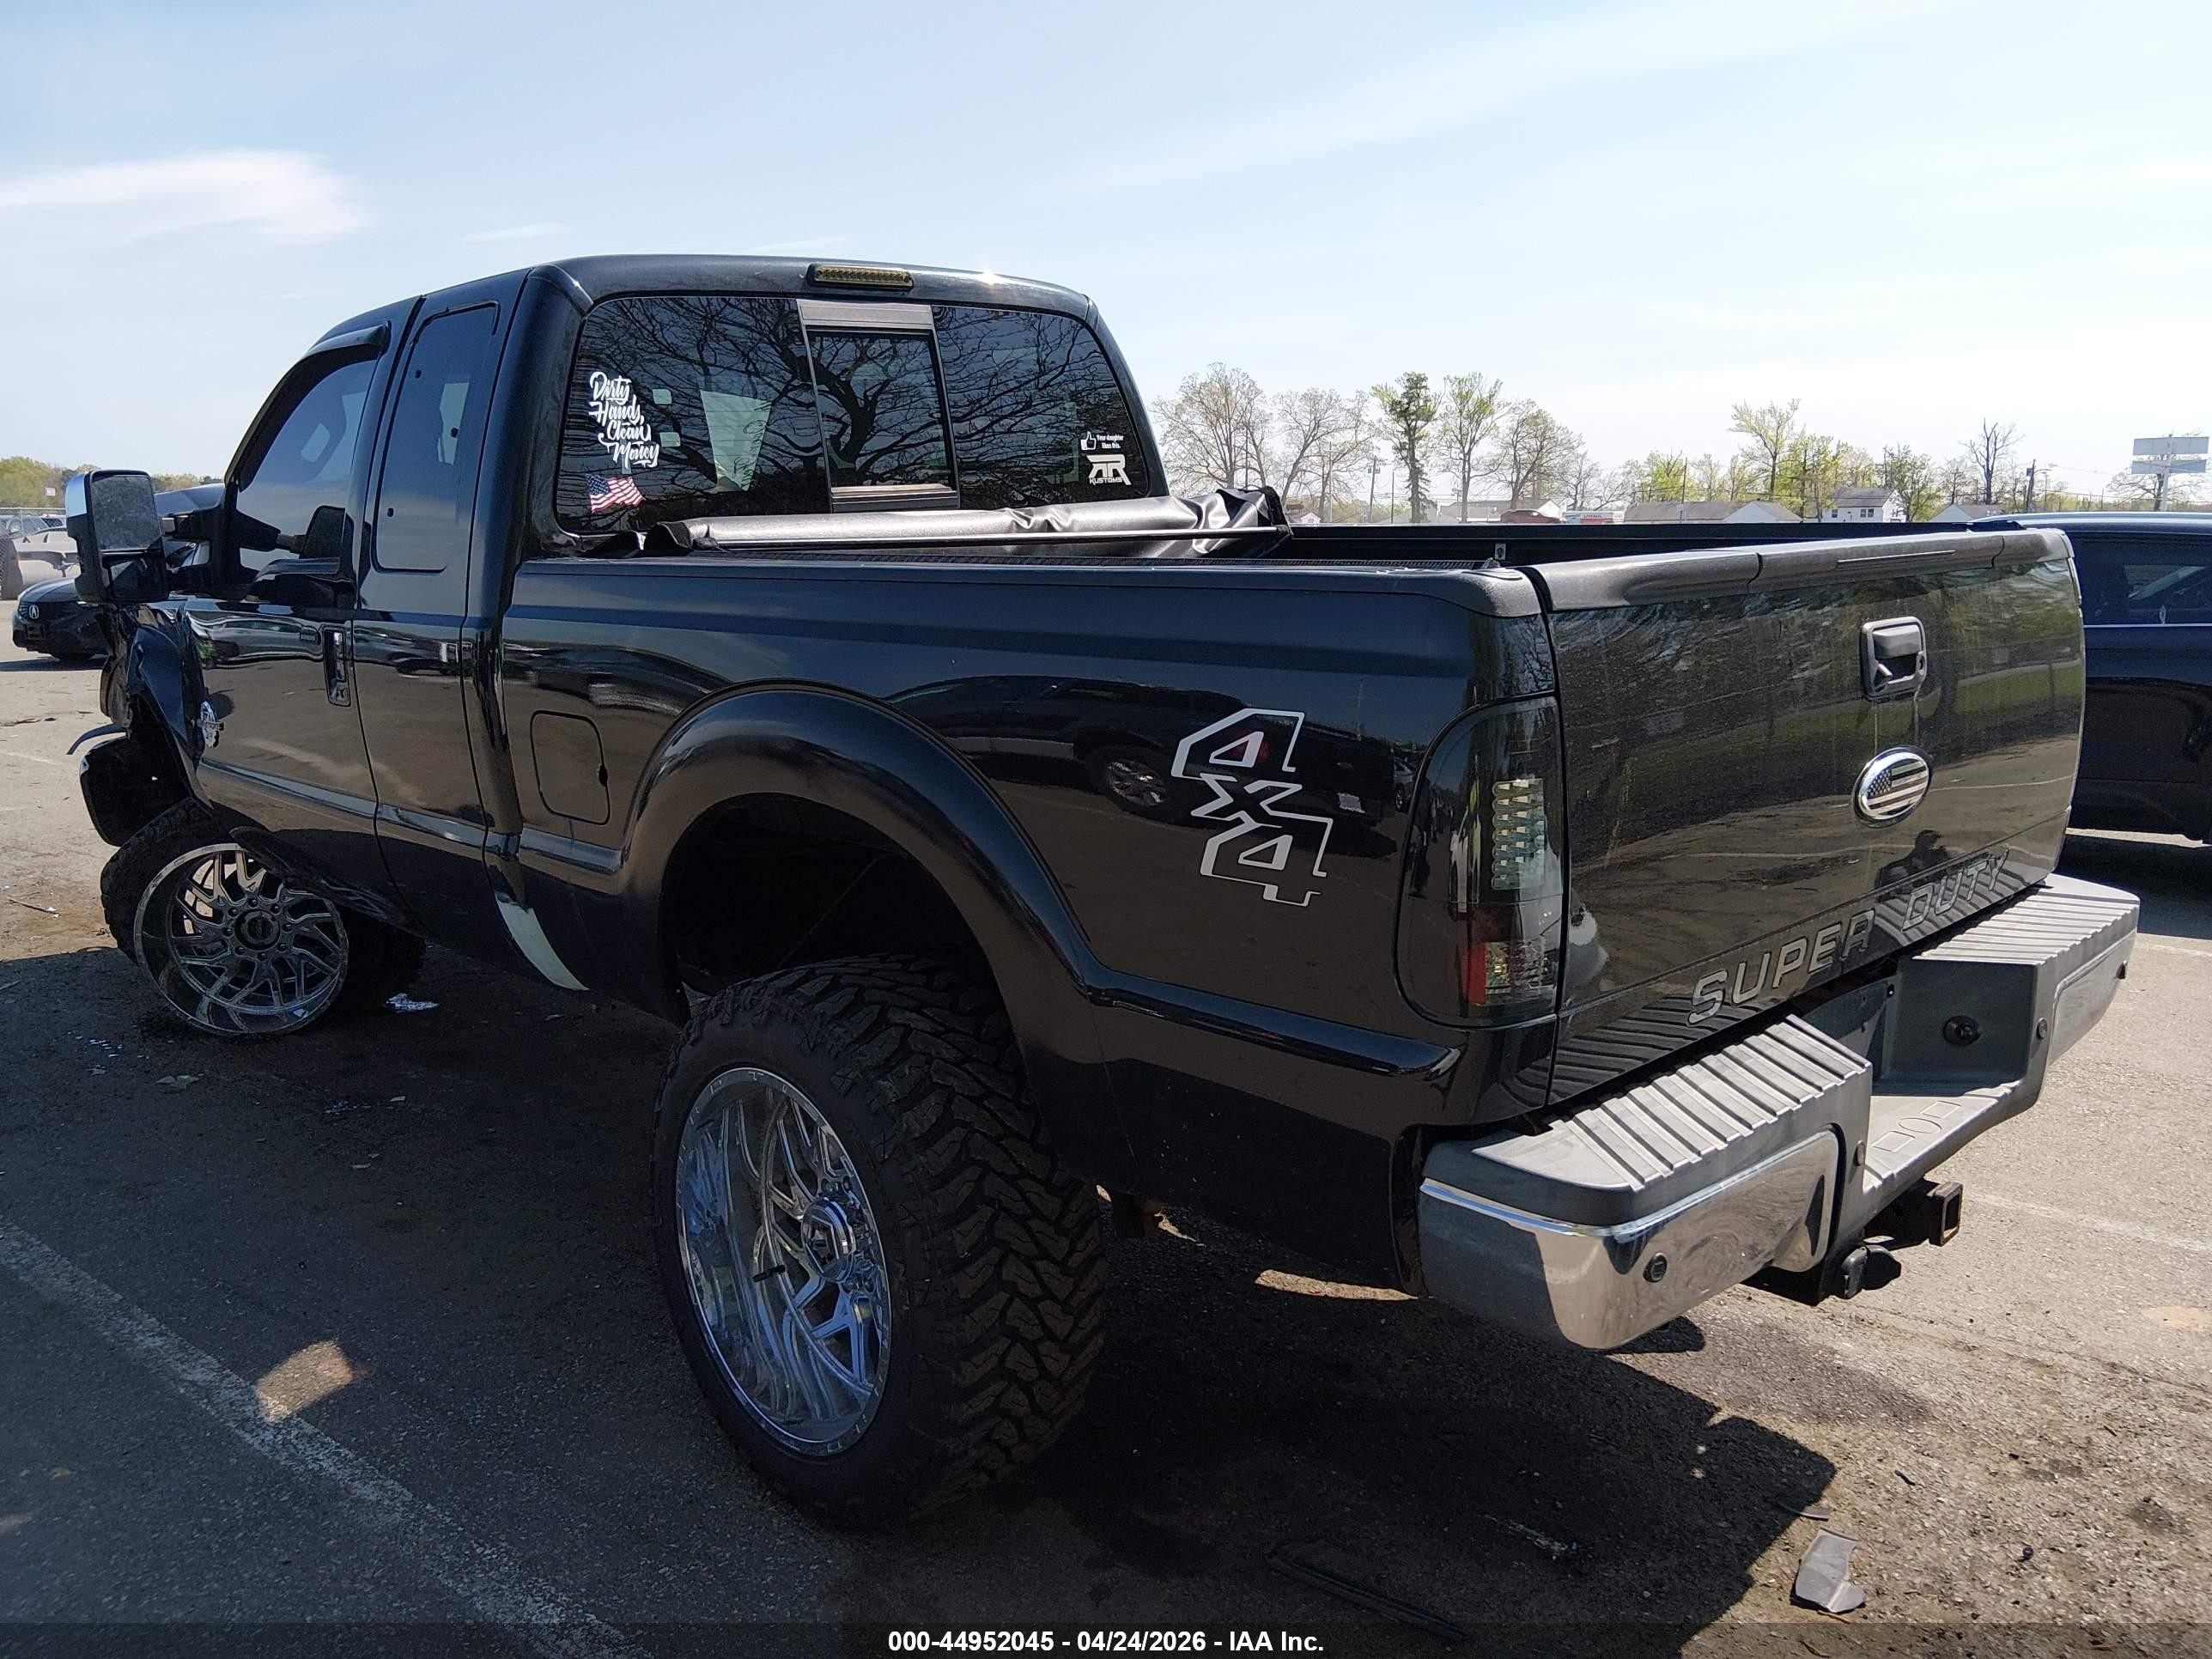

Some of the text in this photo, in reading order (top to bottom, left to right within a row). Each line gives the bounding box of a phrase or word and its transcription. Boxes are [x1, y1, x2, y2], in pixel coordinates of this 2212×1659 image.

[590, 371, 632, 405] Dirty
[606, 419, 652, 442] Clean
[598, 432, 659, 468] Money
[1089, 477, 1123, 485] KUSTOMS
[1687, 848, 2009, 1025] SUPER DUTY
